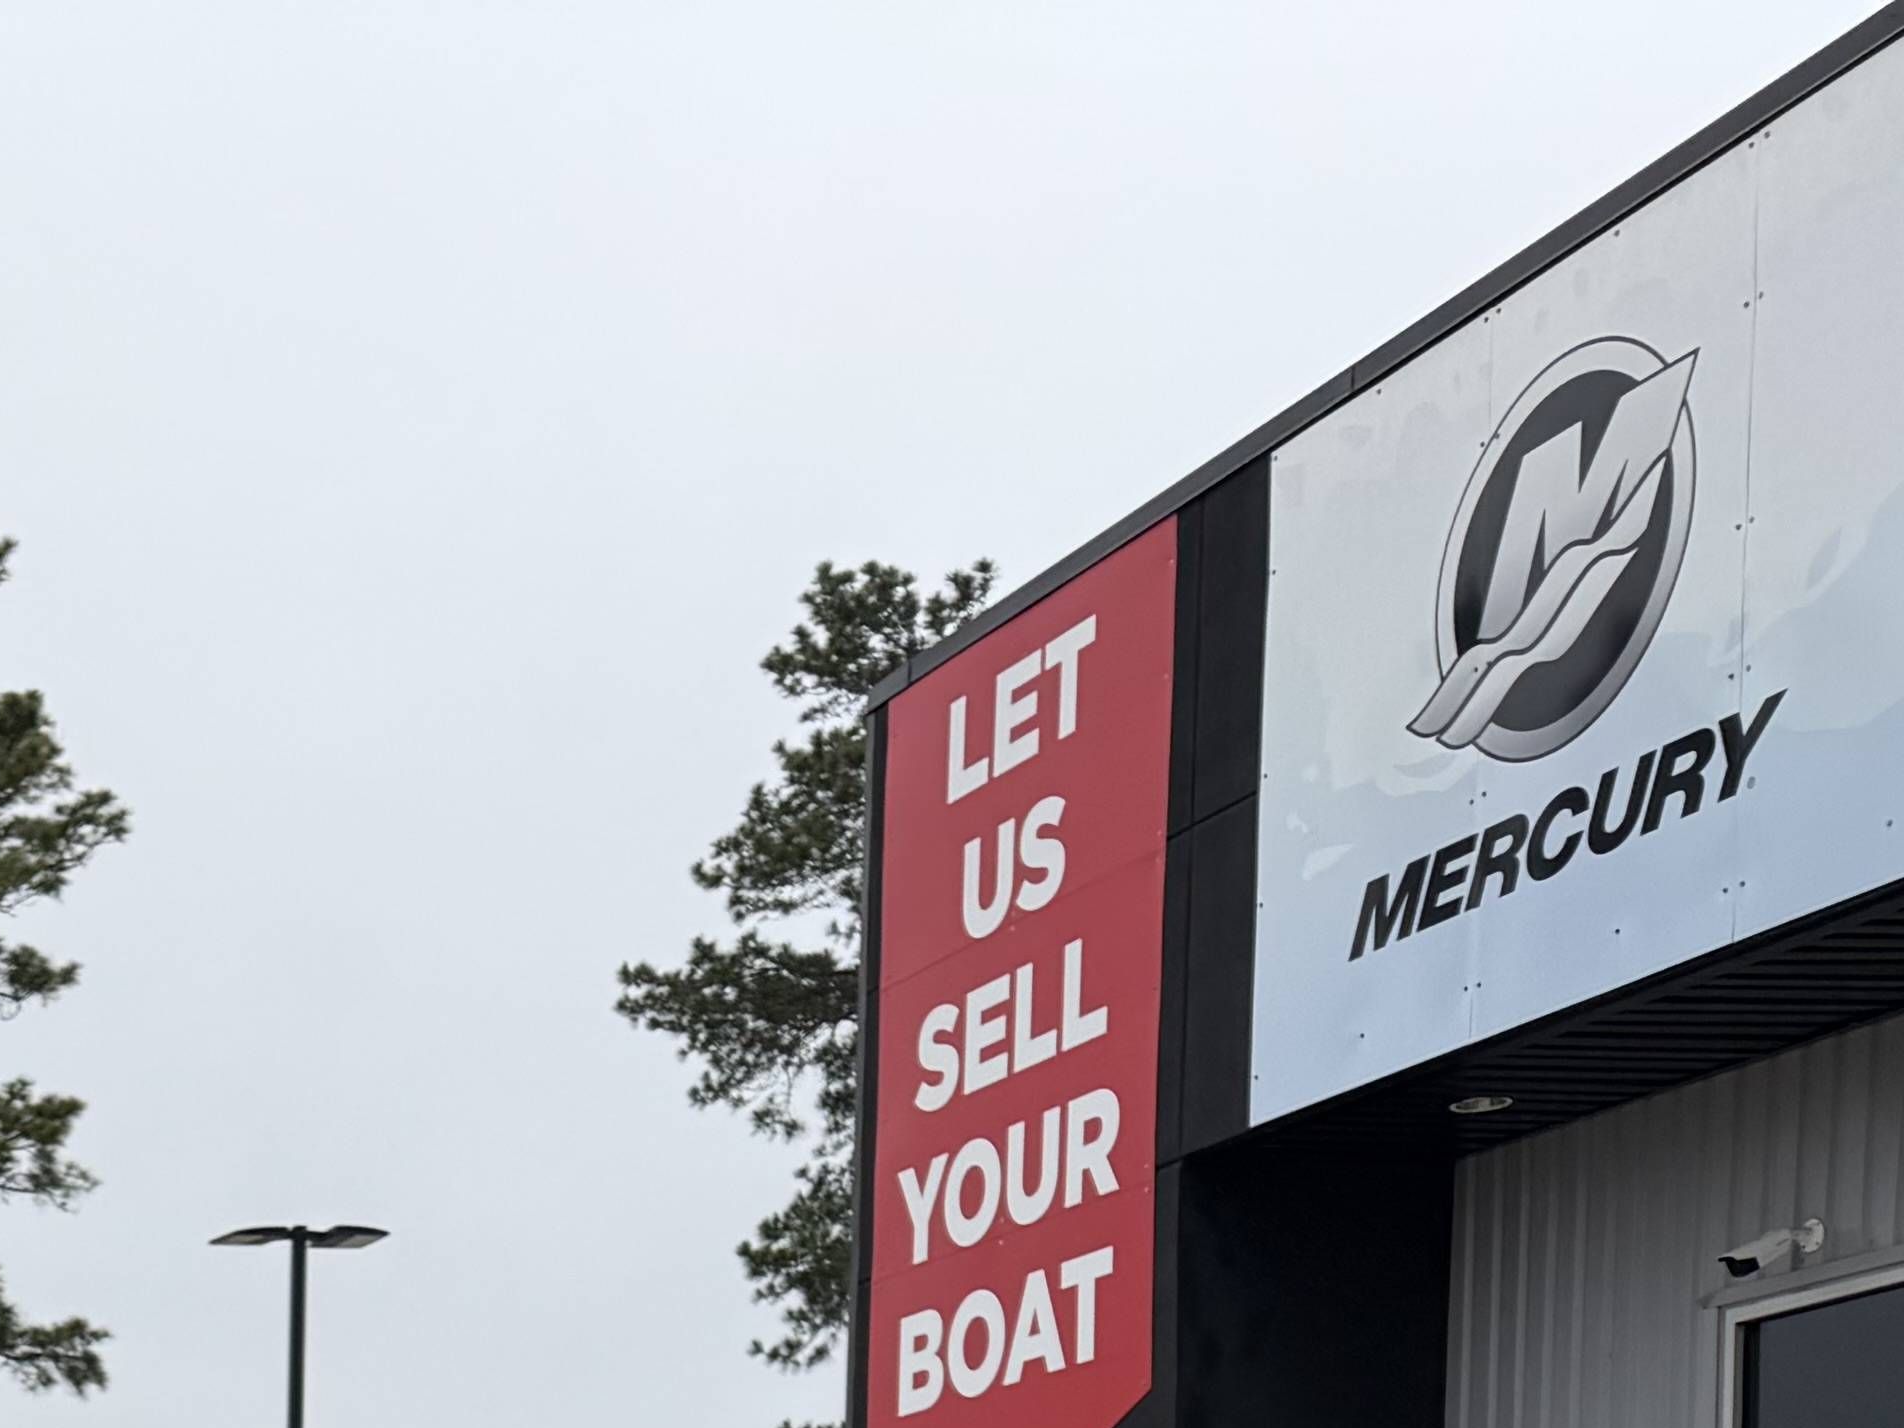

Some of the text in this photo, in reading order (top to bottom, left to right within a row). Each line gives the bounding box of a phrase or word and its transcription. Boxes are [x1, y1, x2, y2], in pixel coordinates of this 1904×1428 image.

[945, 614, 1097, 804] LET
[962, 796, 1066, 938] US
[1348, 688, 1789, 963] MERCURY
[914, 939, 1108, 1112] SELL
[897, 1088, 1120, 1264] YOUR
[897, 1246, 1114, 1416] BOAT
